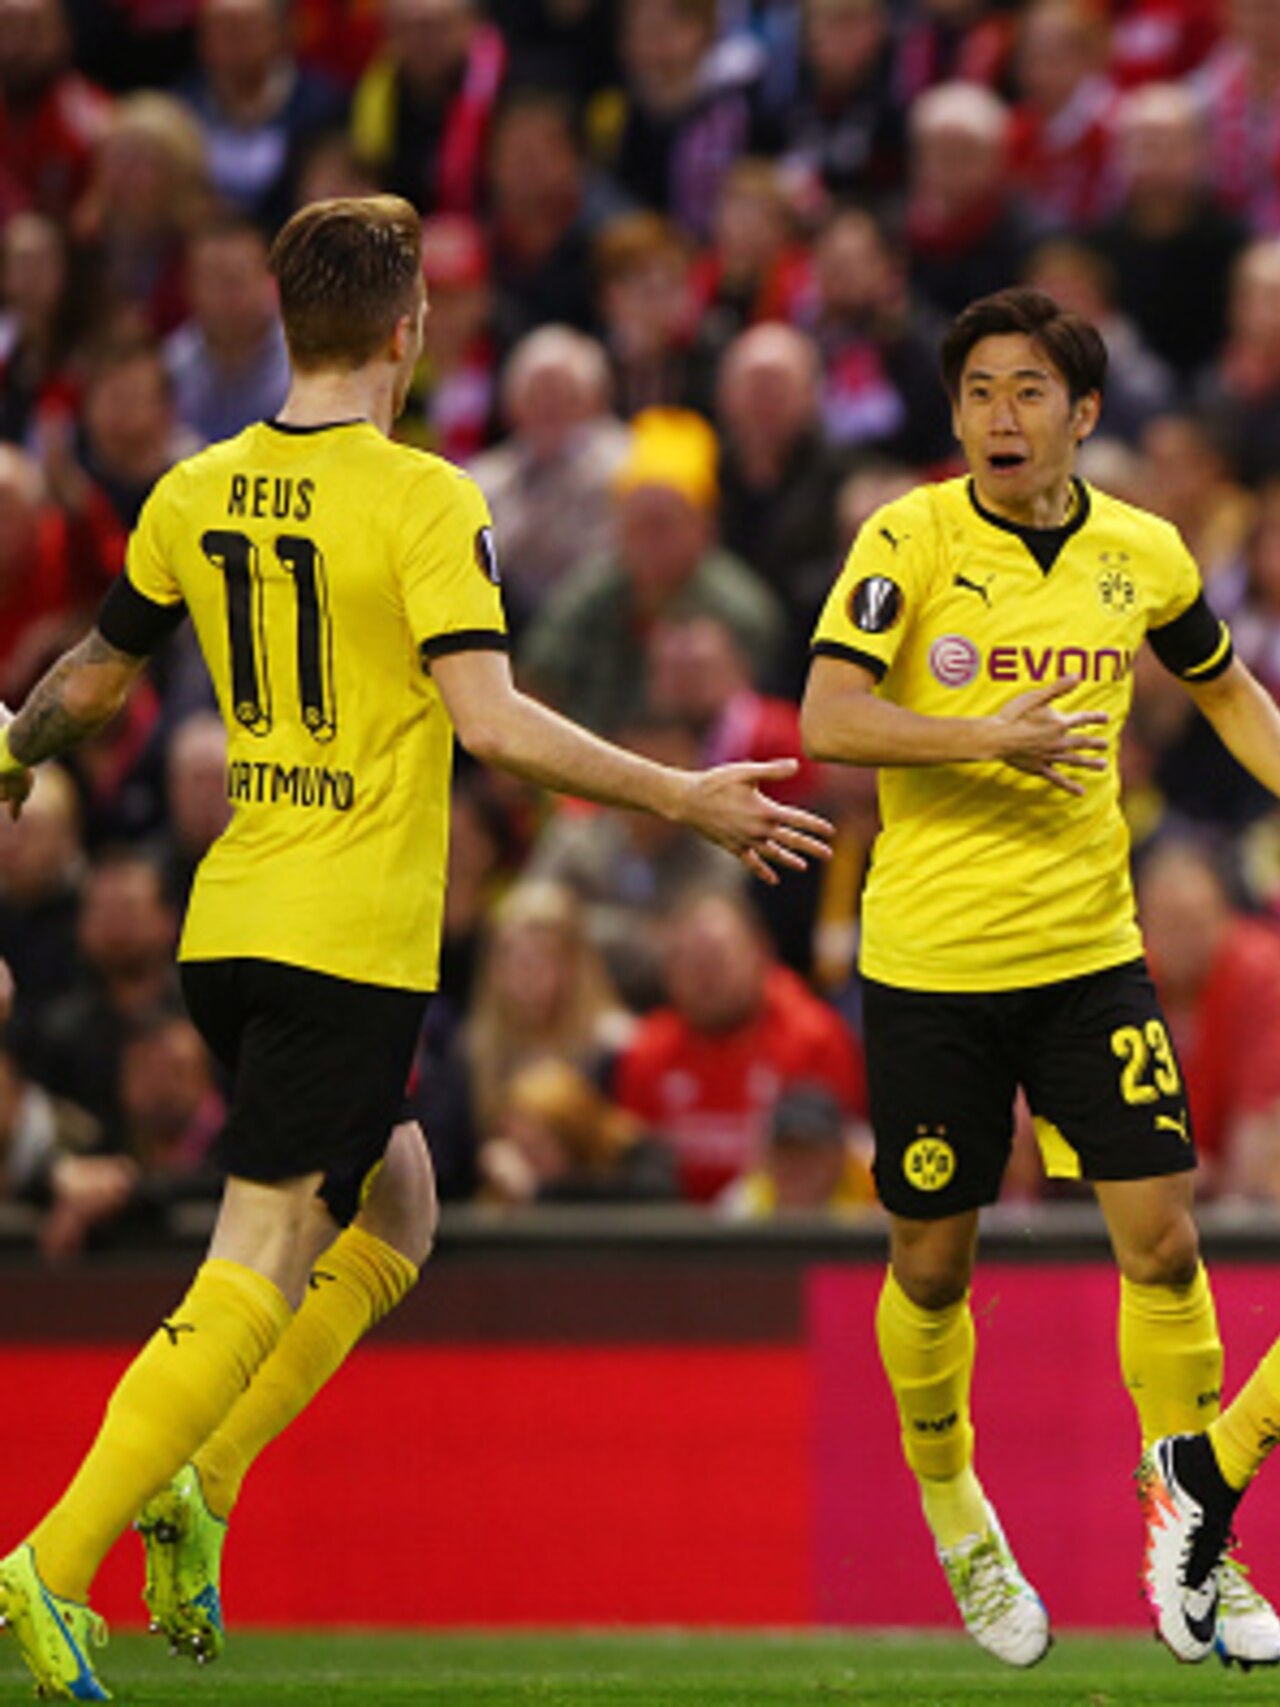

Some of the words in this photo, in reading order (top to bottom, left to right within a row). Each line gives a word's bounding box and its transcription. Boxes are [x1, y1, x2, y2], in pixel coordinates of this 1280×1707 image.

[228, 474, 315, 521] REUS
[200, 530, 336, 745] 11
[1110, 1019, 1180, 1104] 23
